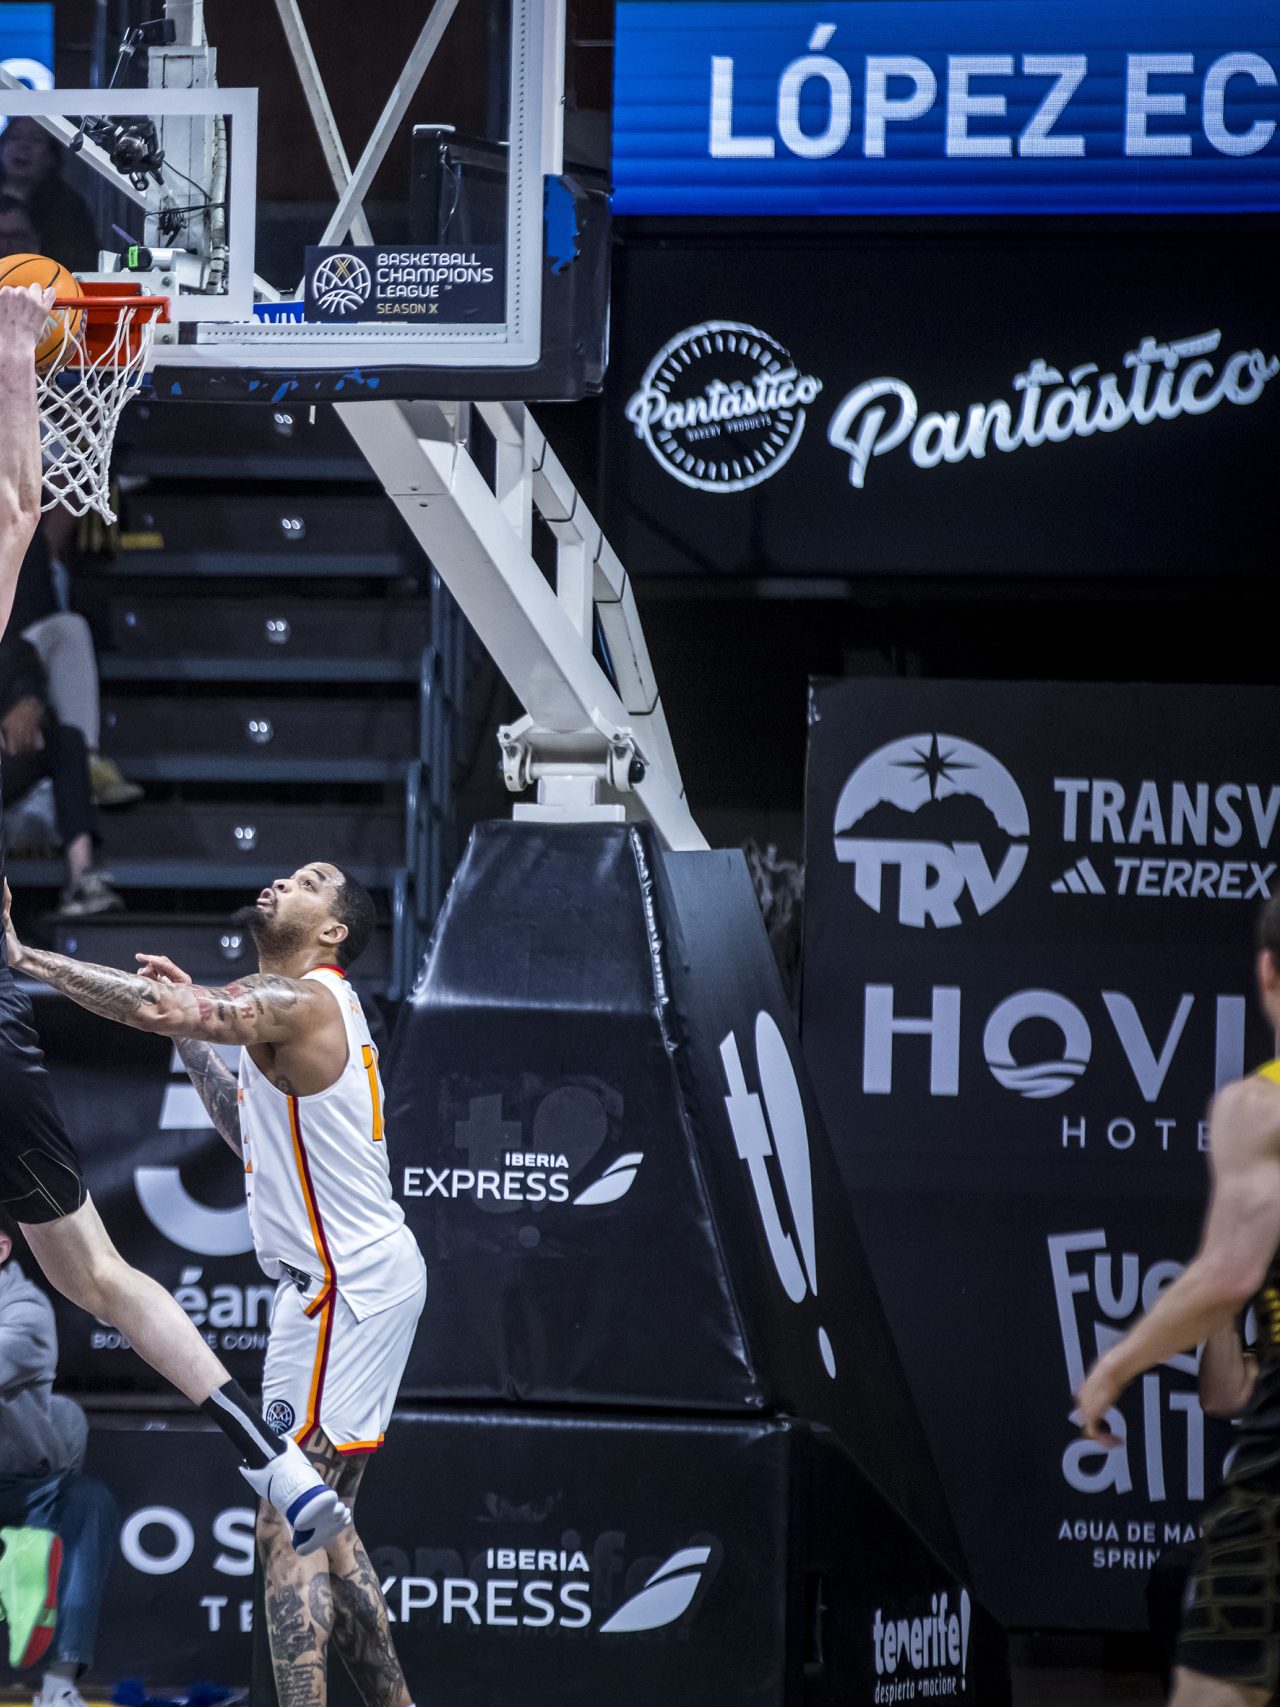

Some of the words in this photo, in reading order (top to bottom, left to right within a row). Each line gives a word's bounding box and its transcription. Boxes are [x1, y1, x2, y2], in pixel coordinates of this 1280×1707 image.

[709, 23, 1087, 159] LÓPEZ
[1125, 52, 1278, 158] EC
[377, 252, 481, 267] BASKETBALL
[376, 267, 494, 283] CHAMPIONS
[376, 284, 440, 298] LEAGUE
[376, 303, 426, 314] SEASON
[428, 303, 439, 314] X
[624, 366, 823, 440] Pantástico
[827, 327, 1280, 489] Pantástico
[1053, 777, 1280, 849] TRANSV
[1114, 857, 1278, 900] TERREX
[505, 1152, 570, 1168] IBERIA
[403, 1167, 570, 1202] EXPRESS
[1058, 1519, 1120, 1542] AGUA
[1127, 1521, 1156, 1543] DE
[1164, 1522, 1205, 1544] MA
[486, 1548, 590, 1573] IBERIA
